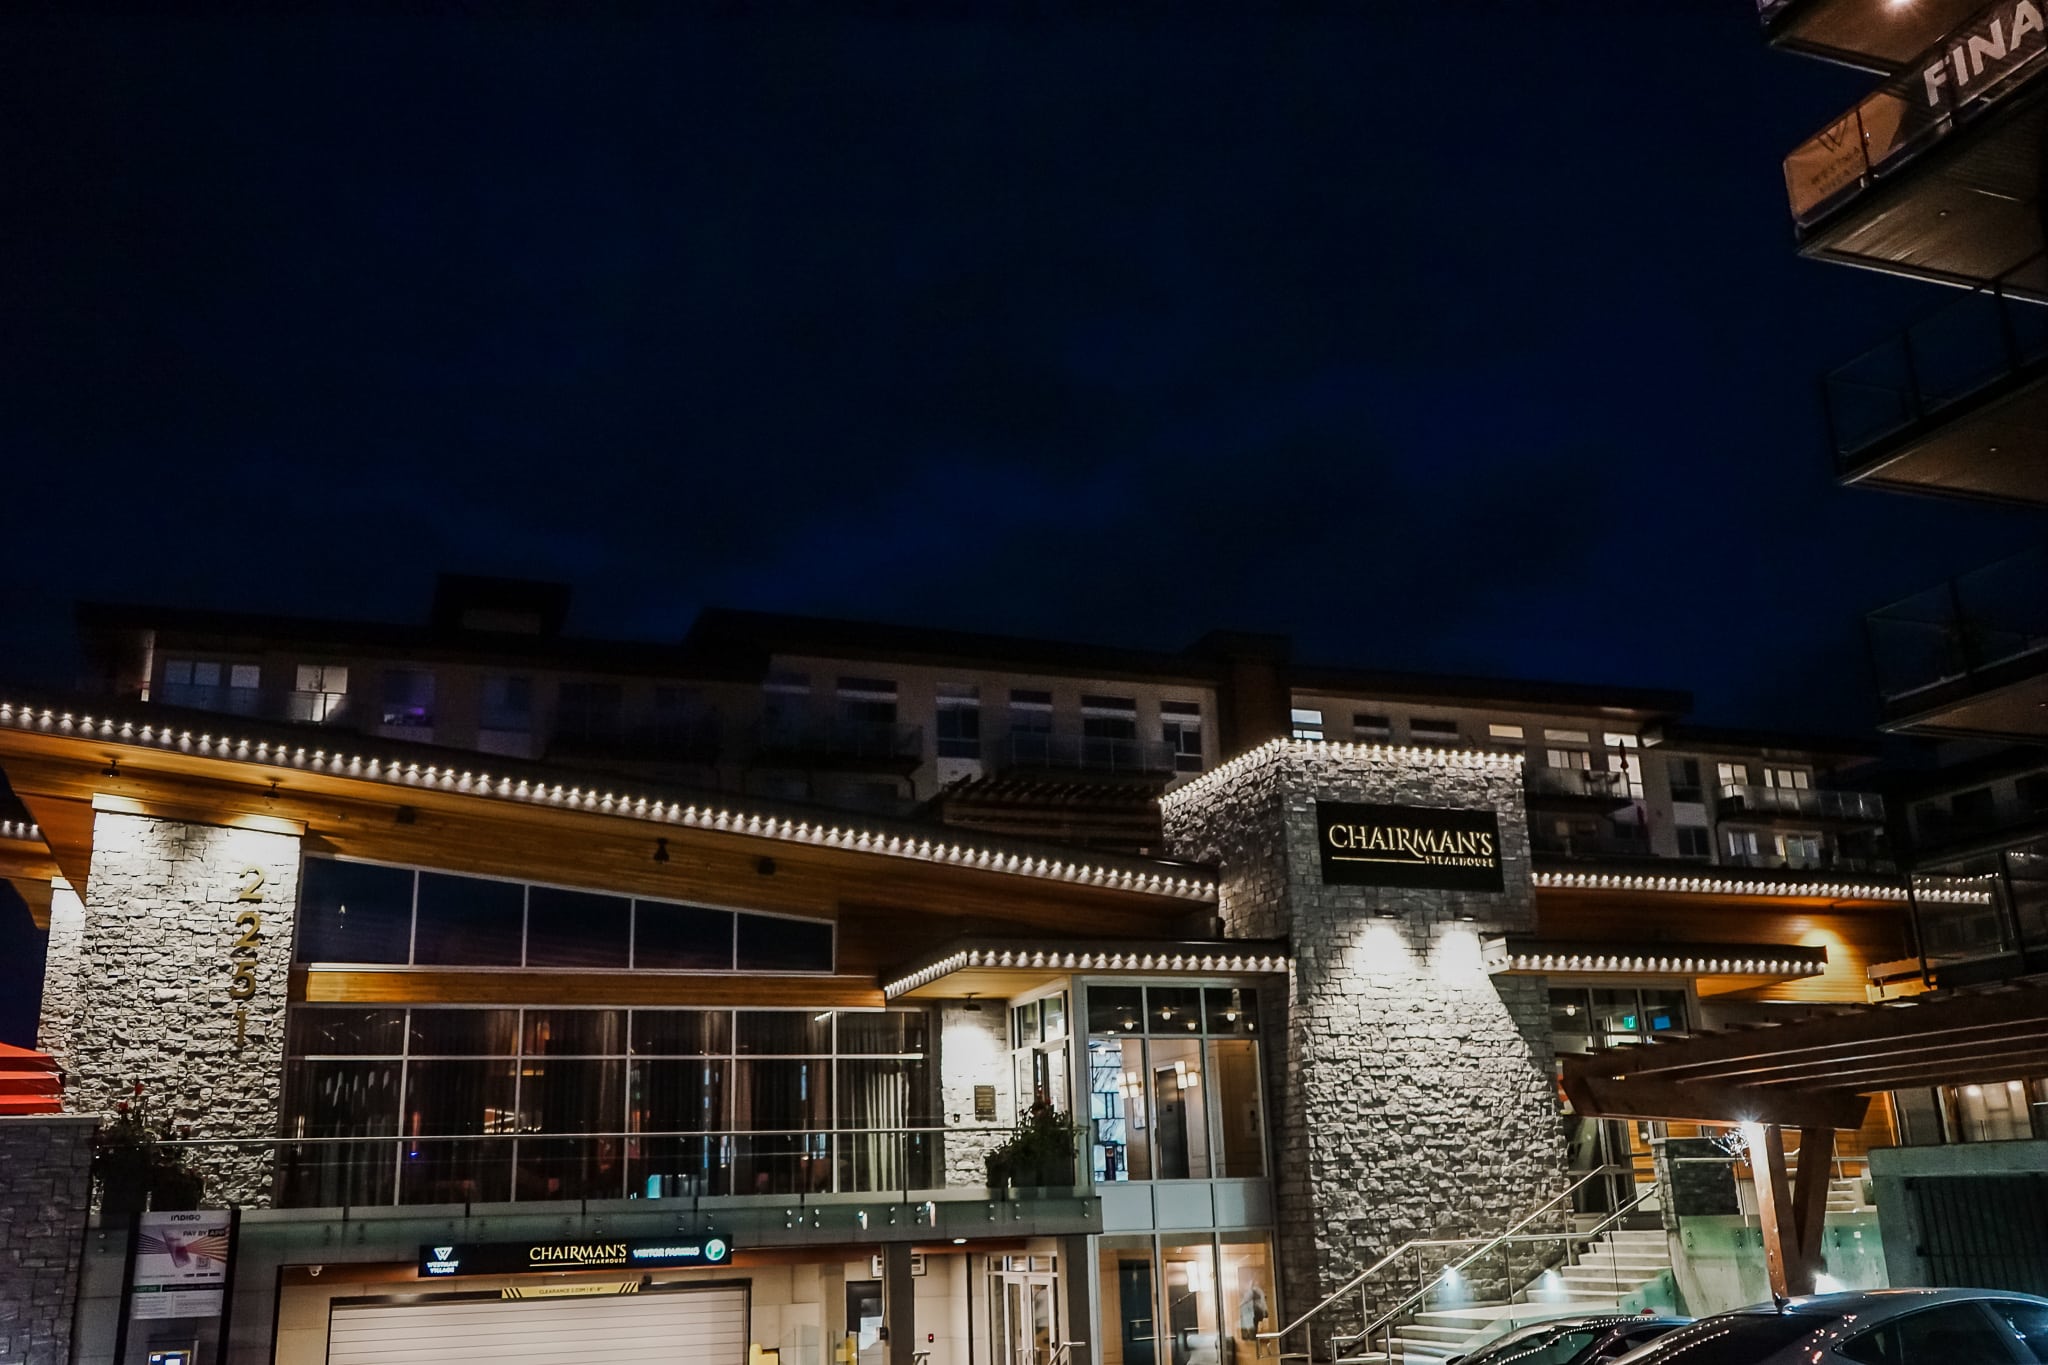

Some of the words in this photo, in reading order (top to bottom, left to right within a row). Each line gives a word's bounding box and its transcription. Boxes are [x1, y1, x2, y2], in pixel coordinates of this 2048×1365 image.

[1923, 0, 2044, 107] FINA
[1328, 824, 1493, 858] CHAIRMAN'S
[1424, 855, 1495, 868] STEAKHOUSE
[229, 863, 265, 1047] 2251
[529, 1243, 627, 1262] CHAIRMAN'S
